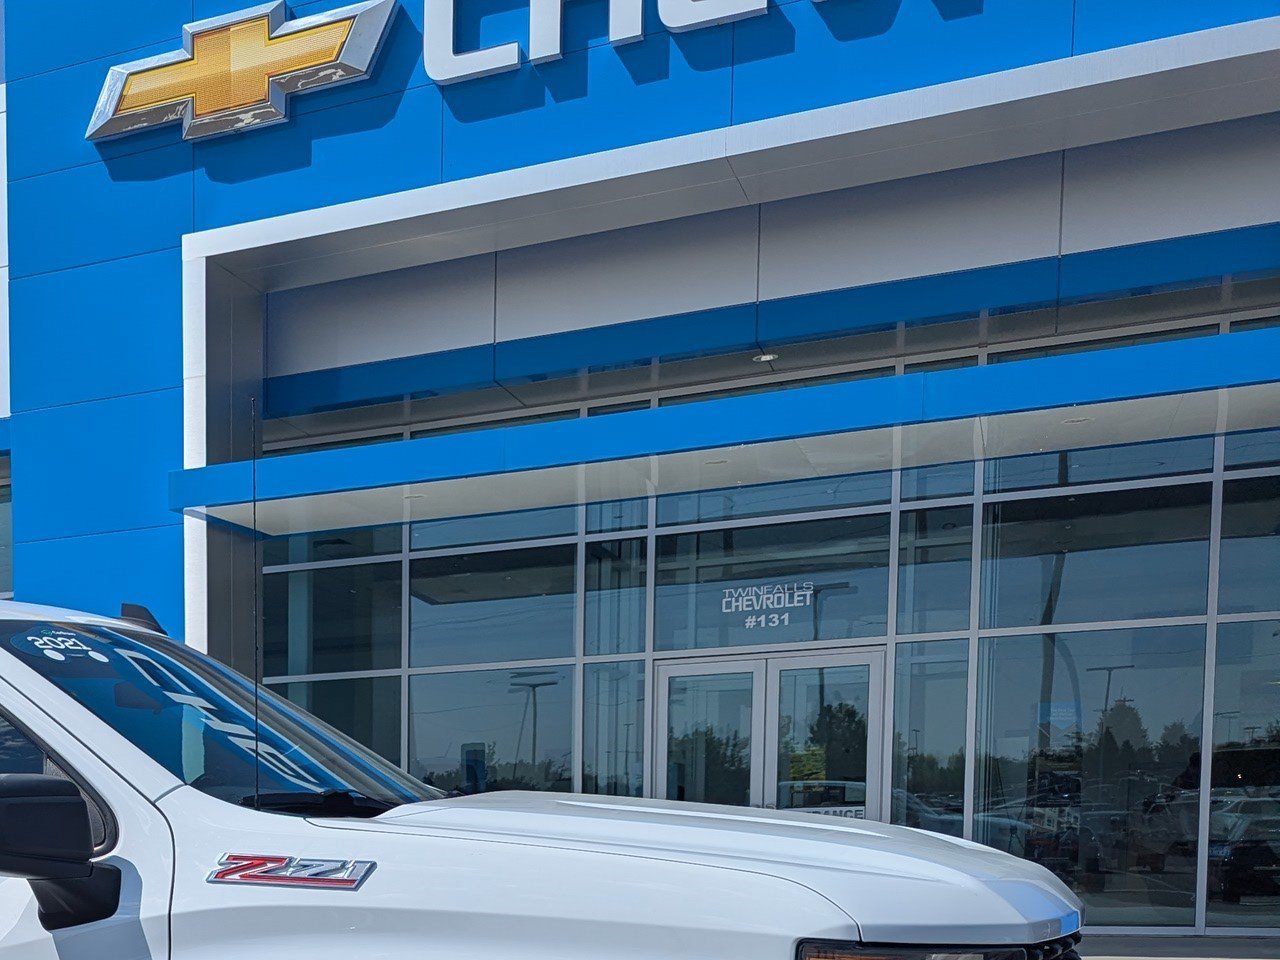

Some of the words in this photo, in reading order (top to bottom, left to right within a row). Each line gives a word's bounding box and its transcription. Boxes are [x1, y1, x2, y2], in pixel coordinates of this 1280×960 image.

[722, 591, 813, 612] CHEVROLET
[745, 613, 789, 628] #131
[27, 637, 92, 650] 2021
[206, 852, 378, 892] Z71
